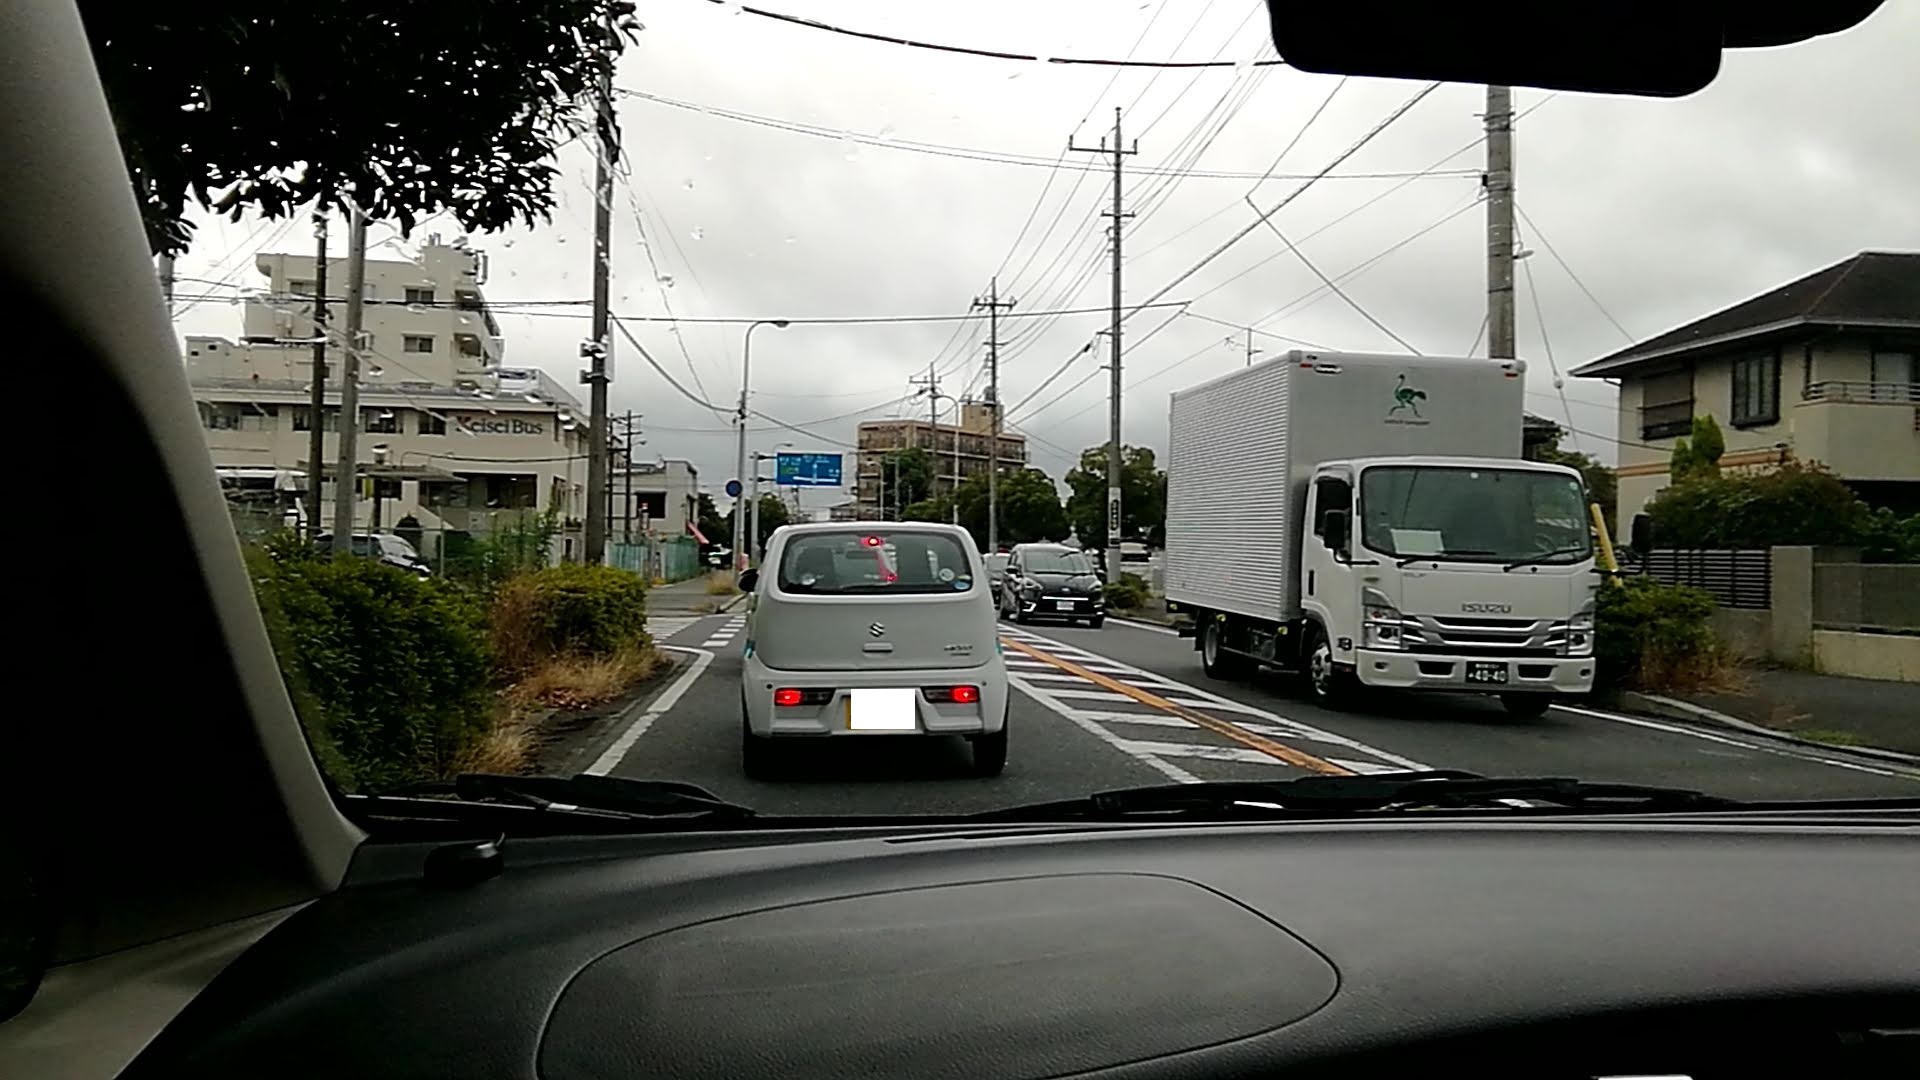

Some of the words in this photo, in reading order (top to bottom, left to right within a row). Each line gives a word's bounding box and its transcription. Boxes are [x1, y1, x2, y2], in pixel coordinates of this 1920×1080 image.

[455, 415, 509, 435] Keisei
[512, 418, 543, 435] Bus
[1461, 603, 1512, 614] ISUZU
